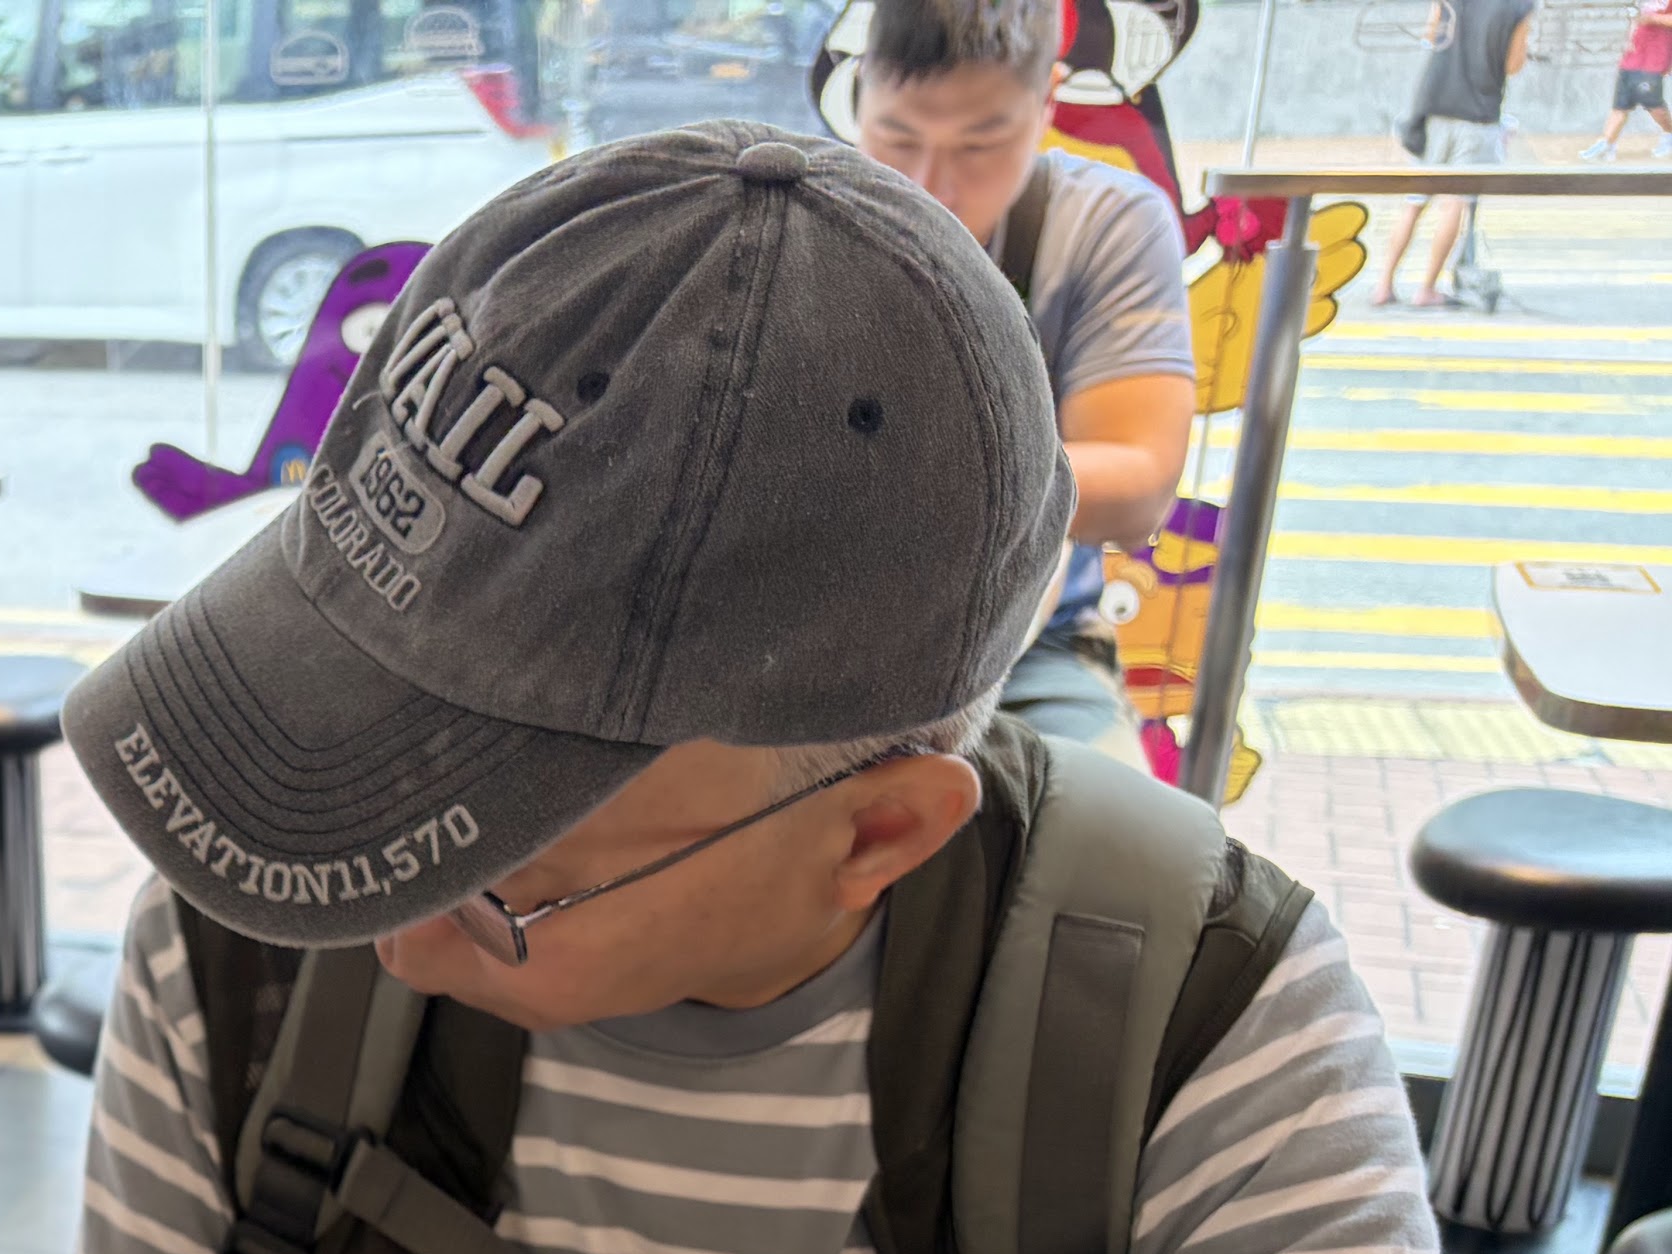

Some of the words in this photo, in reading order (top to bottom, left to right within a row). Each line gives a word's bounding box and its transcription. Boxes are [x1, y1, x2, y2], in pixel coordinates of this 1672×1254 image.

[359, 446, 427, 540] 1962
[379, 297, 566, 527] VAIL
[306, 464, 423, 612] COLORADO
[114, 722, 330, 906] ELEVATION
[329, 804, 480, 901] 11,570
